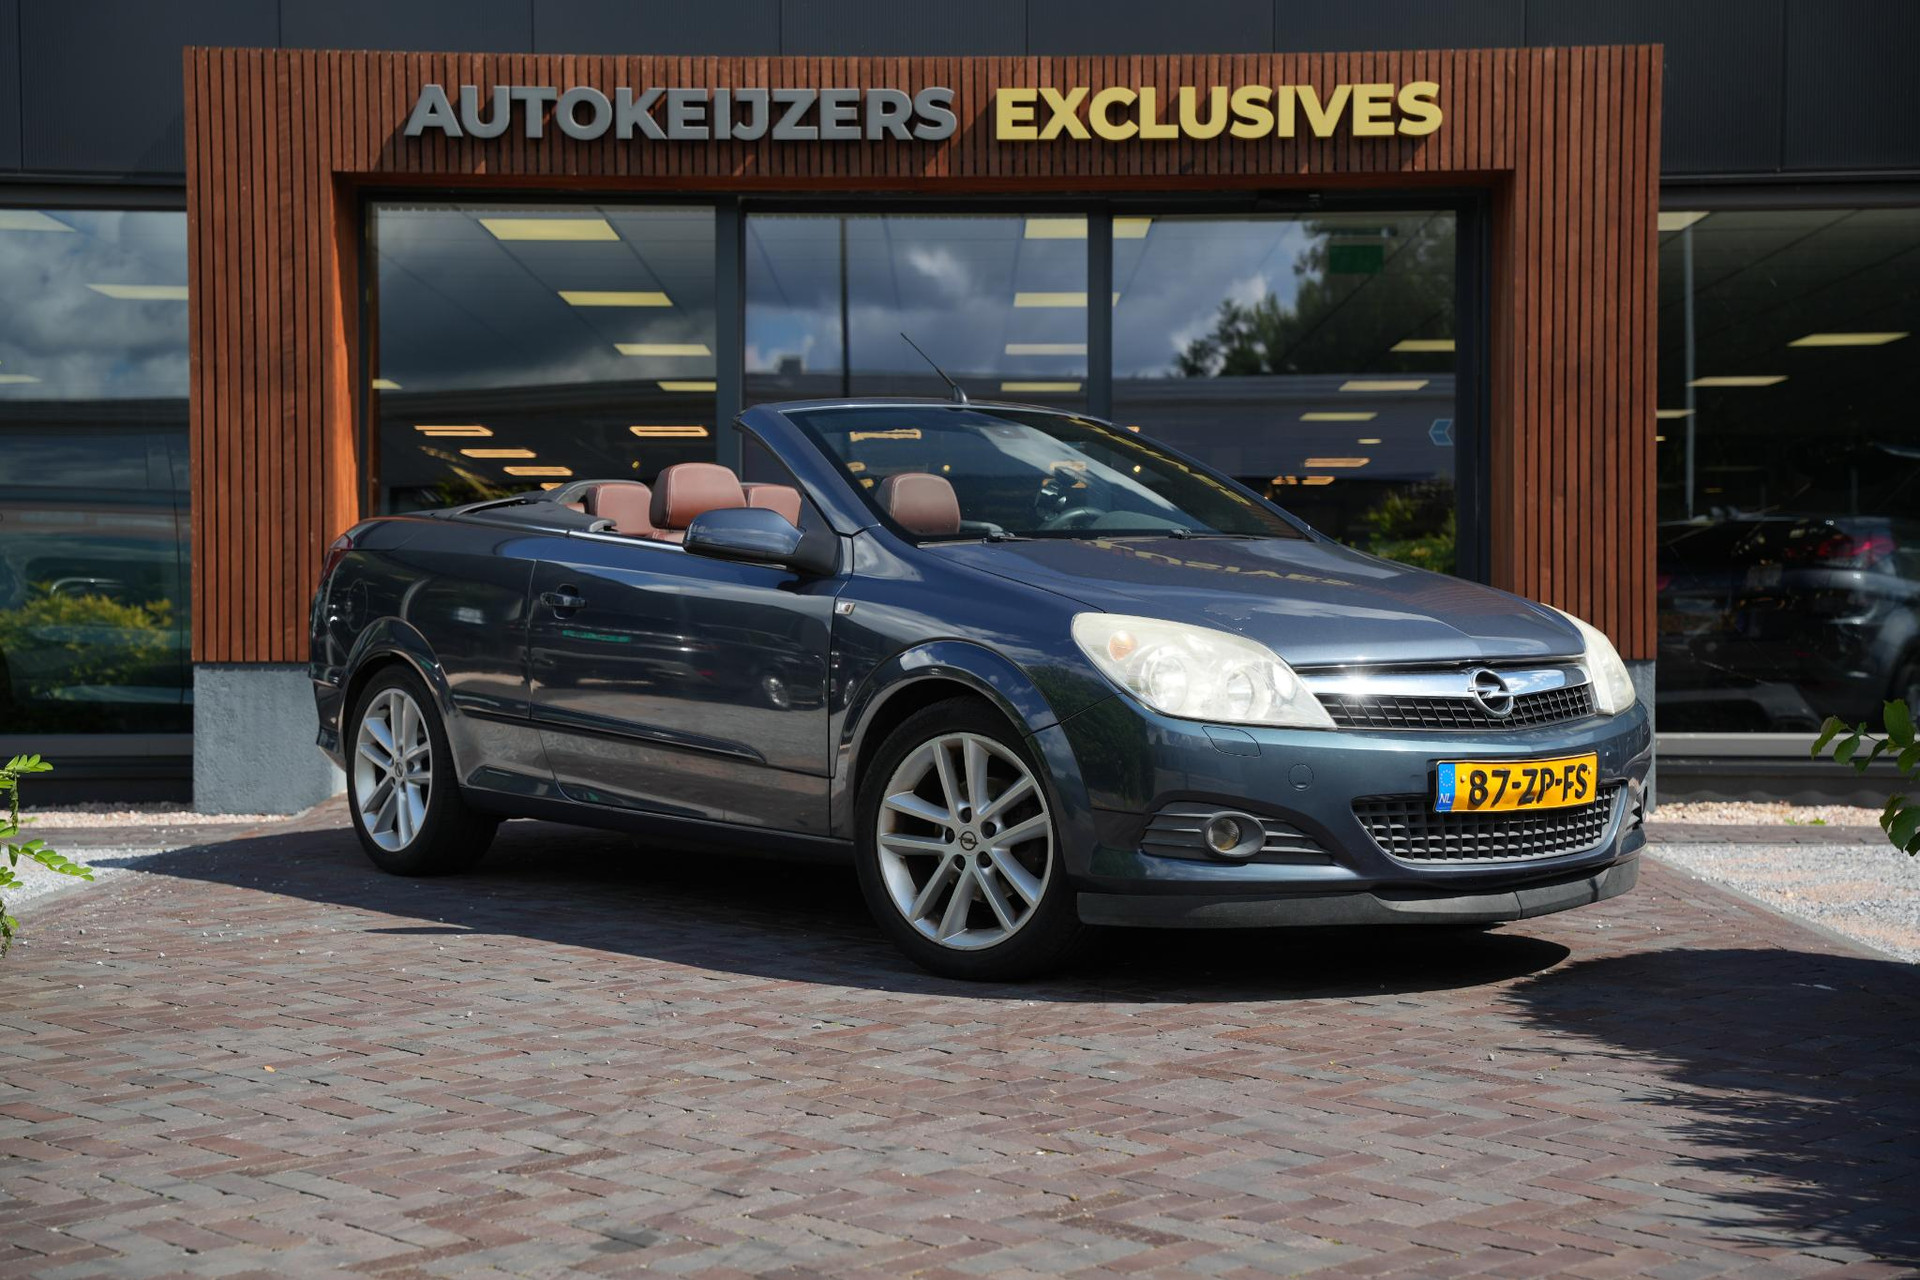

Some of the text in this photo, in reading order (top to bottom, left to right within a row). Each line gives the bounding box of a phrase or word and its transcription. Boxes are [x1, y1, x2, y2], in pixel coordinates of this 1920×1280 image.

[403, 81, 1443, 142] AUTOKEIJZERS EXCLUSIVES
[1439, 792, 1452, 804] NL
[1469, 763, 1588, 807] 87-ZP-FS
